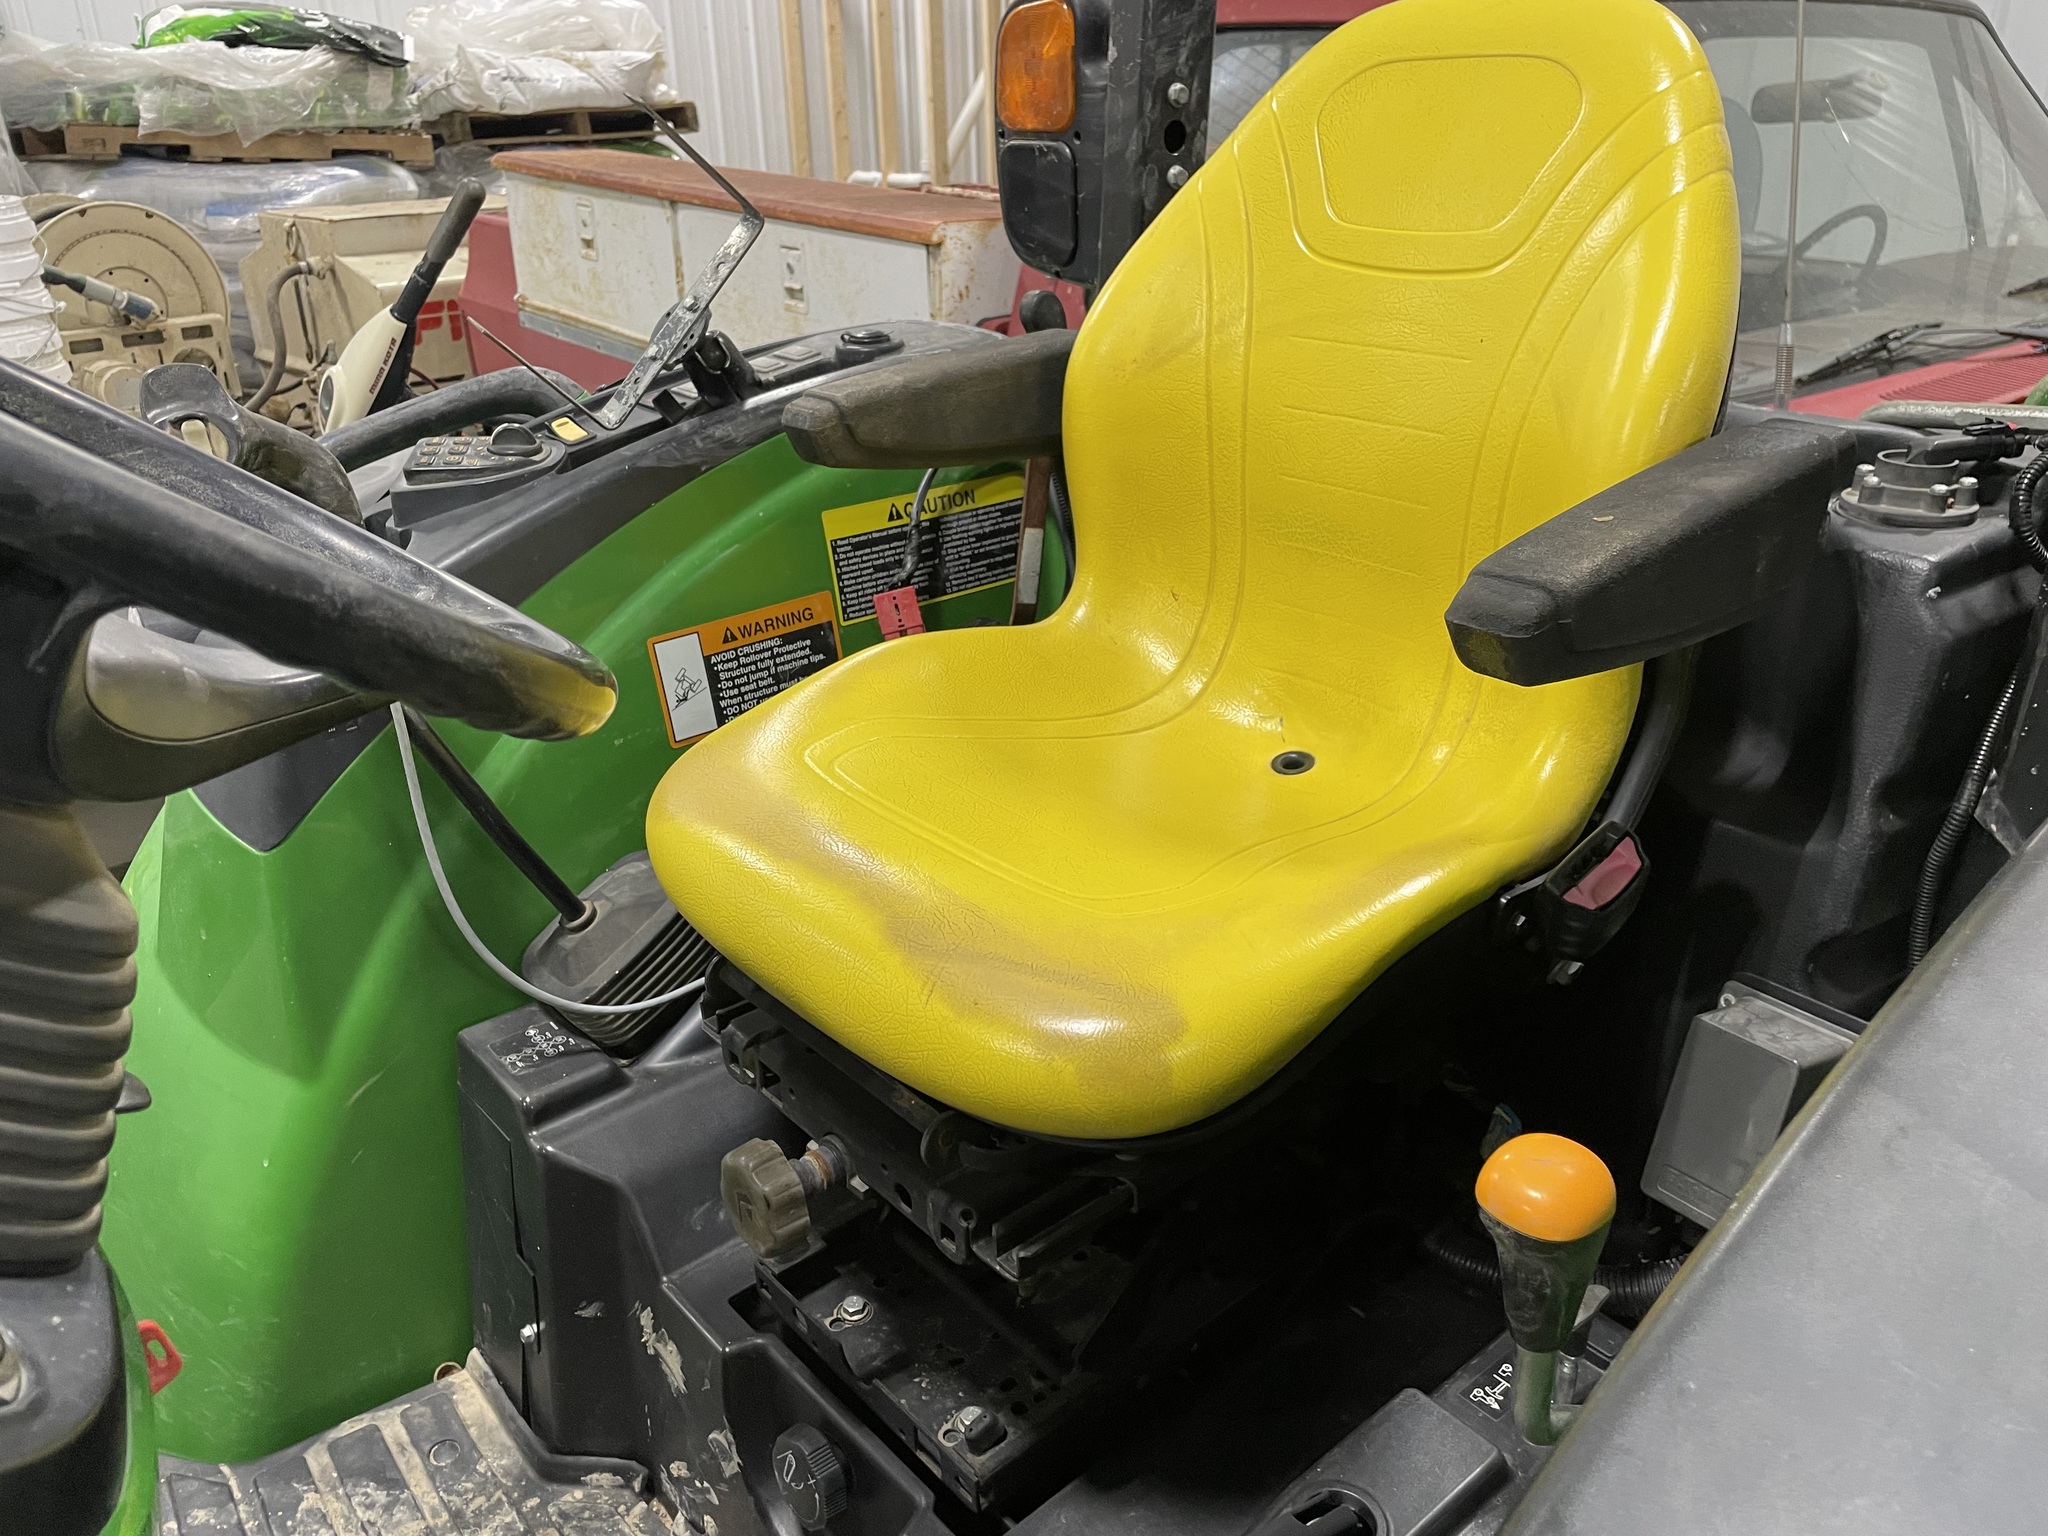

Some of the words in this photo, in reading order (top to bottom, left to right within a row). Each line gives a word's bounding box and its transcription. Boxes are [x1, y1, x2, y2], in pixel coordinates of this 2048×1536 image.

[738, 608, 814, 639] WARNING
[710, 649, 736, 664] AVOID
[738, 638, 783, 657] CRUSHING:
[717, 658, 738, 671] Keep
[740, 650, 772, 665] Rollover
[774, 639, 811, 657] Protective
[719, 665, 756, 680] Structure
[757, 660, 774, 674] fully
[775, 647, 812, 665] extended.
[721, 678, 733, 689] Do
[735, 674, 748, 685] not
[749, 669, 769, 684] jump
[770, 667, 776, 676] if
[777, 660, 808, 674] machine
[810, 653, 826, 668] tips.
[719, 695, 742, 708] When
[744, 685, 778, 702] structure
[723, 686, 738, 698] Use
[740, 681, 757, 693] seat
[758, 676, 775, 688] belt.
[727, 703, 739, 715] DO
[741, 700, 758, 713] NOT
